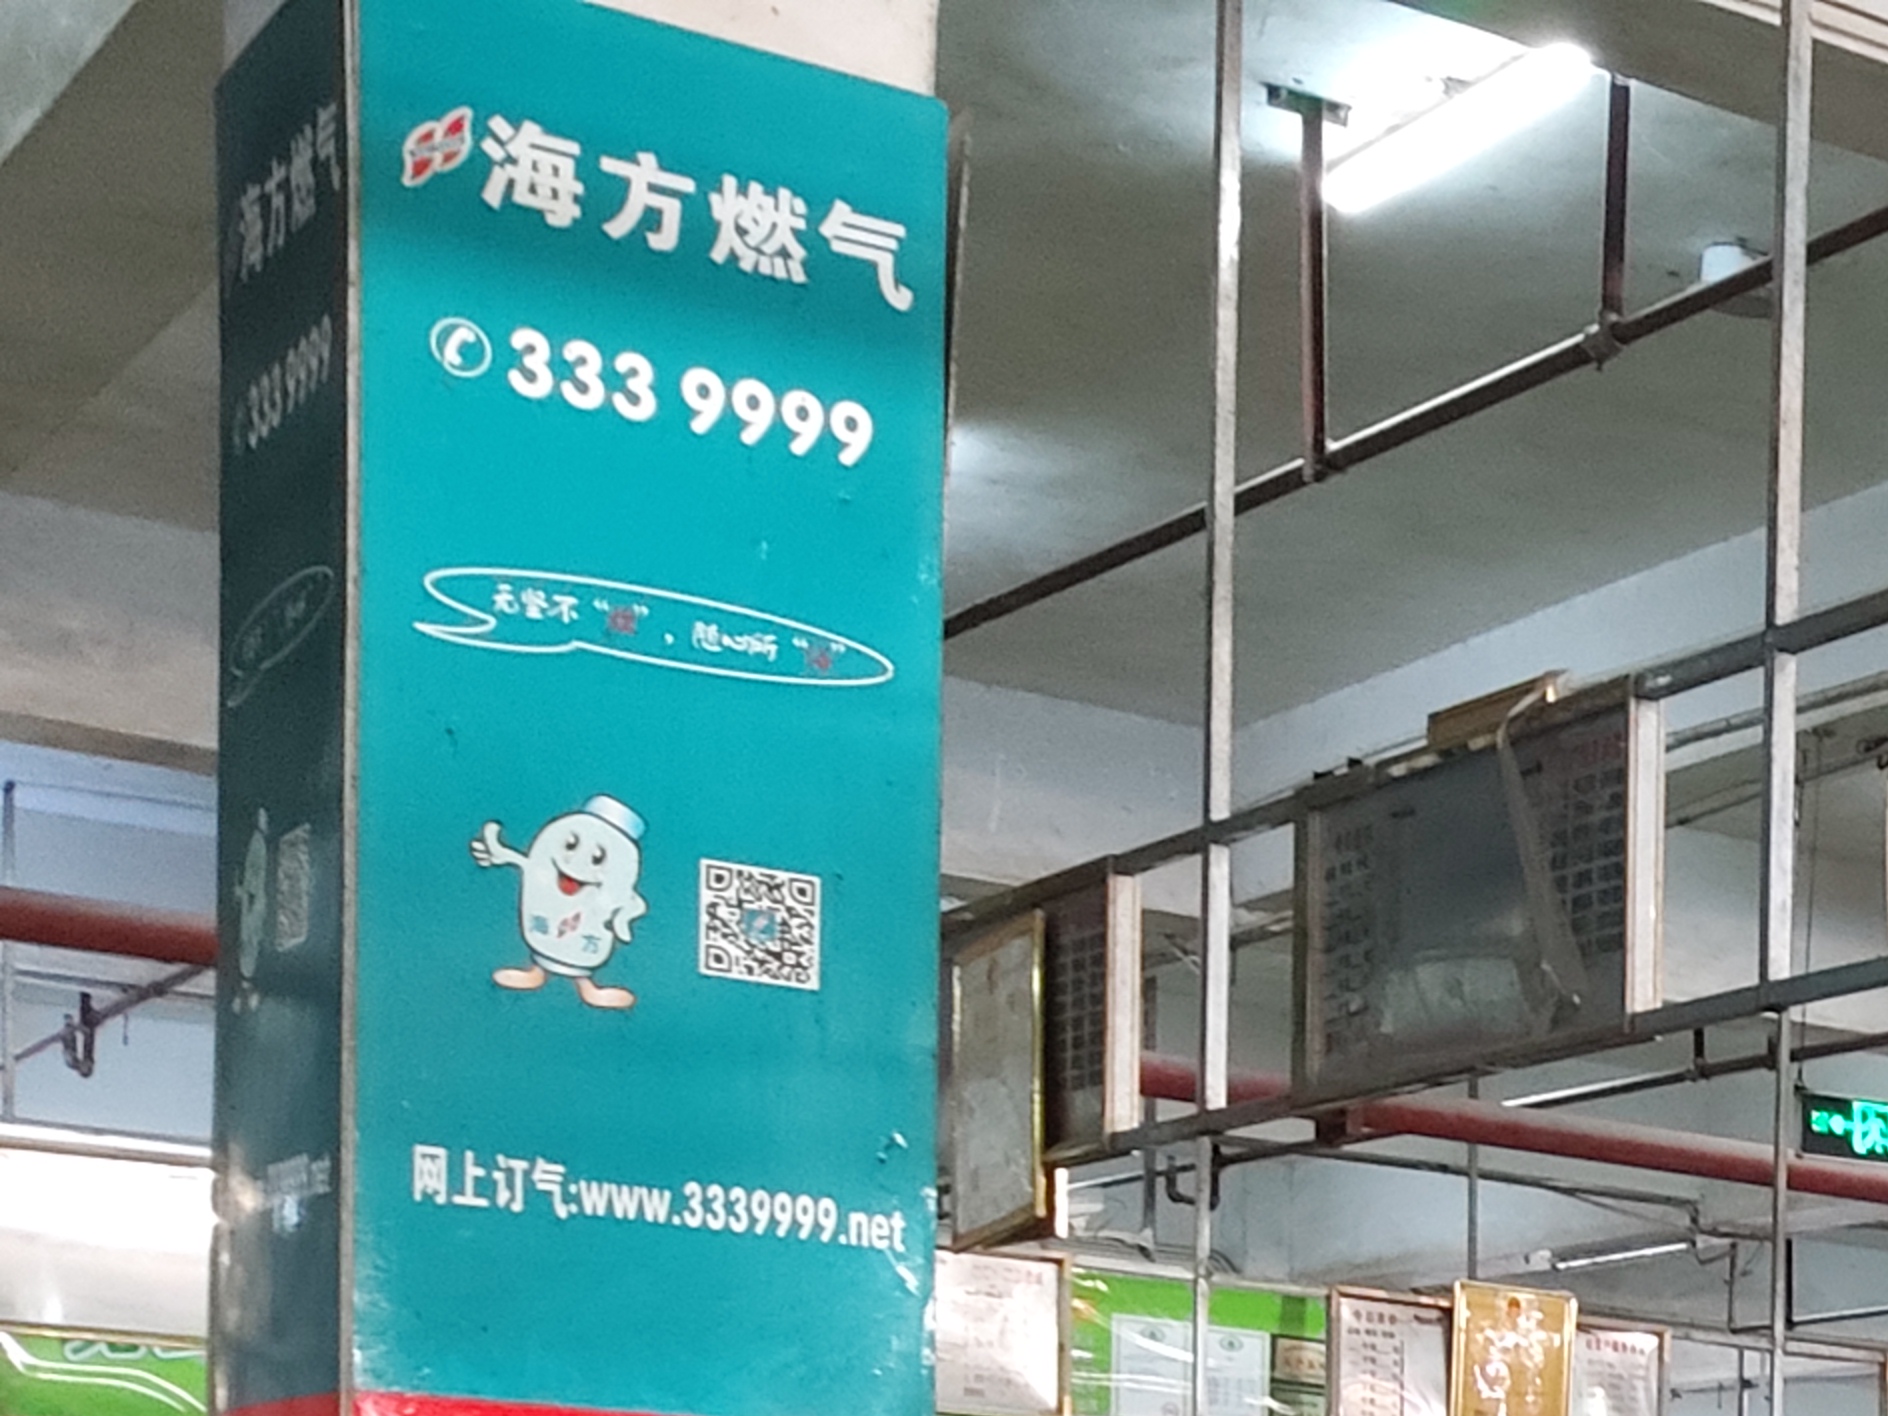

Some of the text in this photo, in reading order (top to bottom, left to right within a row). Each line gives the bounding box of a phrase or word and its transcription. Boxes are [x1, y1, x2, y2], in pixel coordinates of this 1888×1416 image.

[480, 114, 913, 312] 海方燃气
[508, 328, 874, 467] 333 9999
[412, 1143, 906, 1252] 网上订气:www.3339999.net
